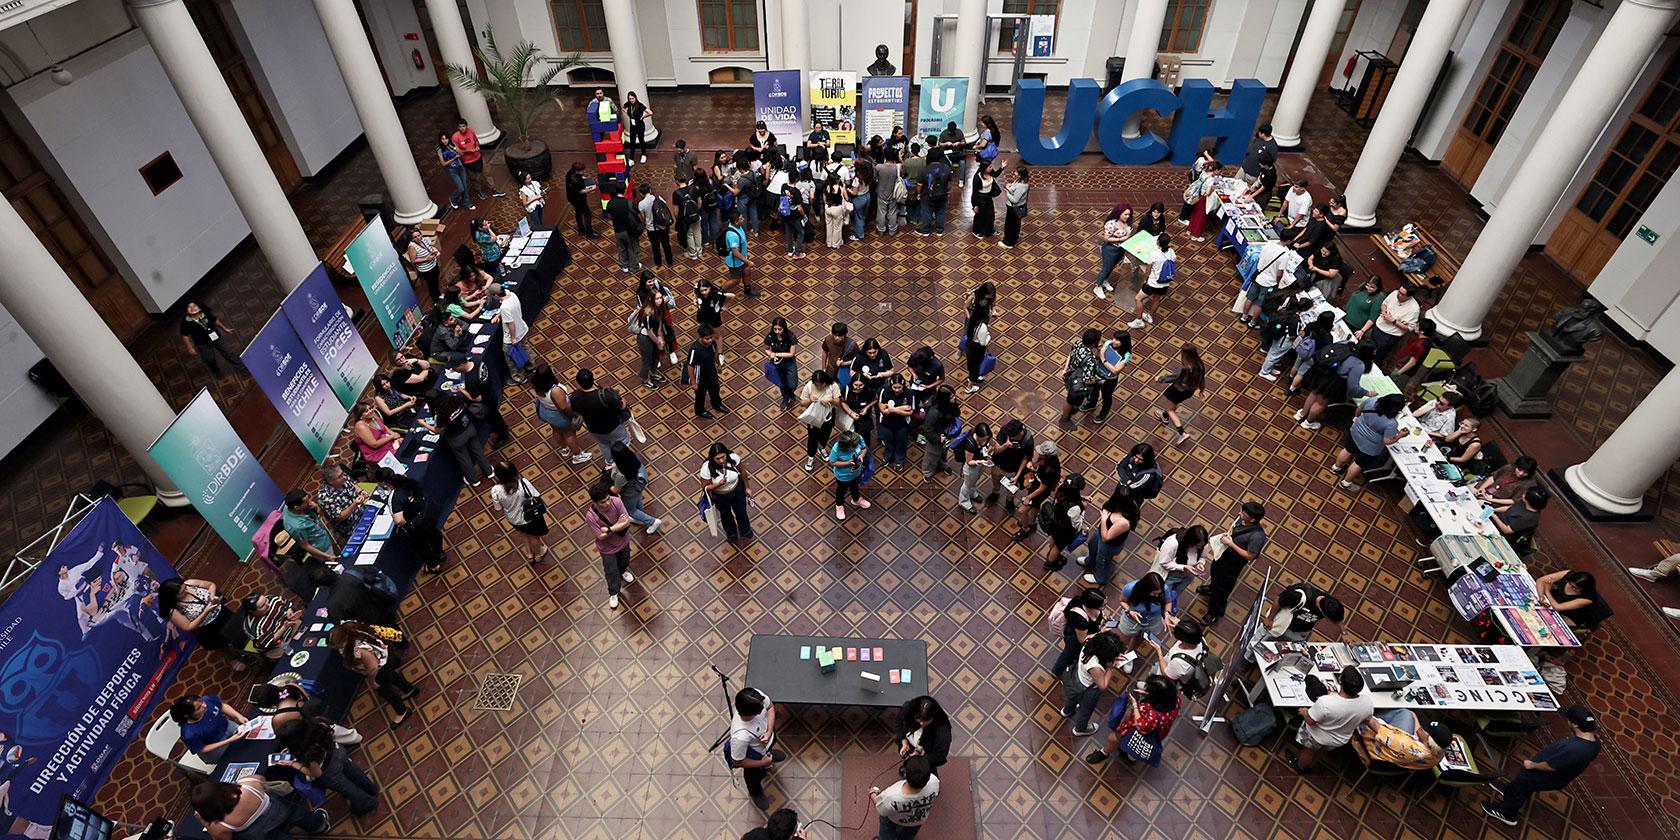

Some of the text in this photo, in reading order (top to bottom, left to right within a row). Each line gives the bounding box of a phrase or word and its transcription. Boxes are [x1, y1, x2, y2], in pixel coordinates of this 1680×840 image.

[760, 105, 797, 114] UNIDAD
[868, 87, 903, 98] PROYECTOS
[931, 87, 955, 112] U
[774, 113, 797, 121] VIDA
[1013, 78, 1268, 166] UCH
[314, 315, 336, 344] FORMULARIO
[320, 320, 348, 355] ESTUDIANTIL
[324, 326, 354, 365] FOCES
[282, 361, 308, 400] BENEFICIOS
[293, 376, 320, 417] UCHILE
[206, 445, 245, 494] DIRBDE
[30, 648, 141, 794] DIRECCIÓN DE DEPORTES
[56, 770, 68, 783] Y
[66, 709, 114, 775] ACTIVIDAD
[110, 672, 142, 711] FÍSICA
